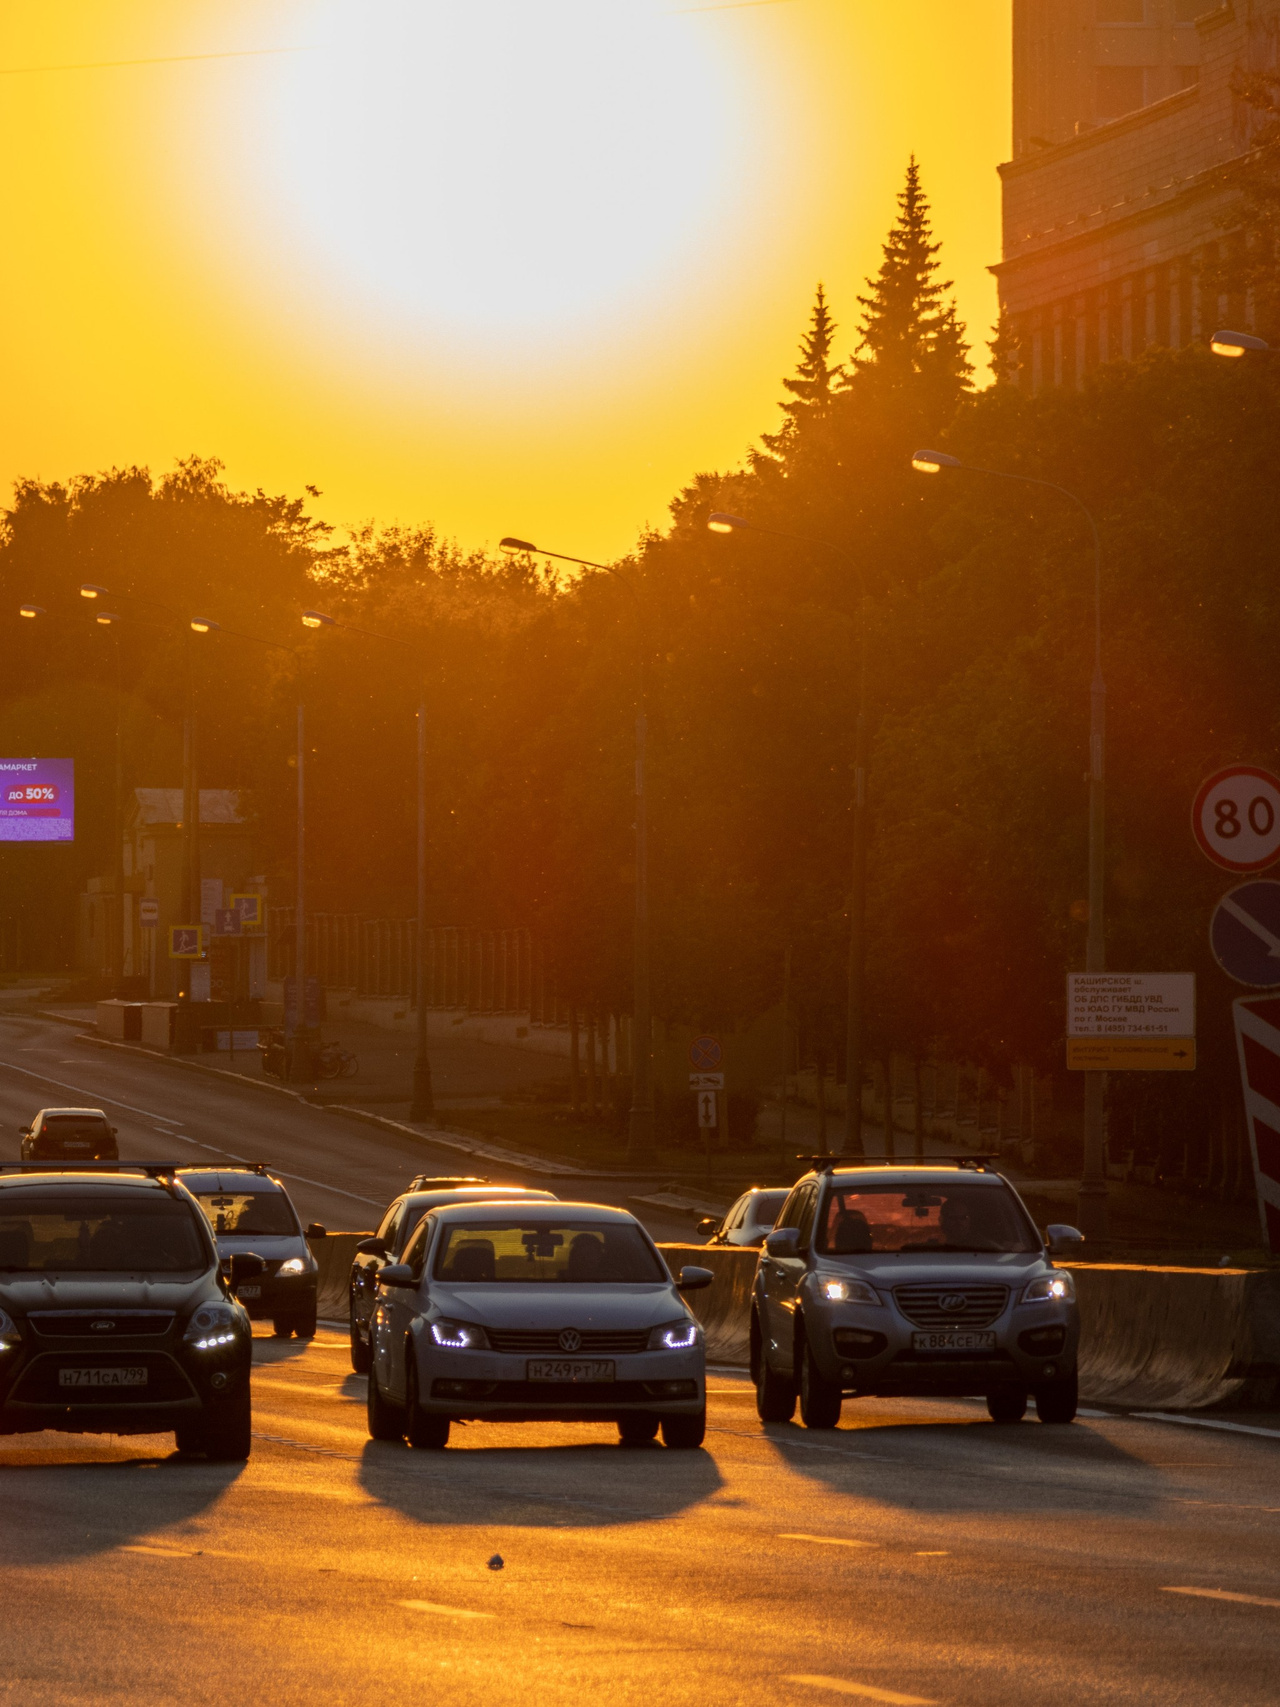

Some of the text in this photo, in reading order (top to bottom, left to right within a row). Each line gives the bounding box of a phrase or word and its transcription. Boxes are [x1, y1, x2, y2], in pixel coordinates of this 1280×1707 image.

[25, 787, 55, 800] 50%
[1214, 795, 1275, 839] 80
[1074, 977, 1132, 985] КАШИРСКОЕ
[1074, 985, 1132, 994] обслуживает
[1074, 995, 1163, 1004] ОБ ДПС ГИБДД УВД
[1087, 1005, 1109, 1013] ЮАО
[1111, 1005, 1123, 1013] ГУ
[1125, 1005, 1145, 1013] МВД
[1147, 1005, 1180, 1013] России
[1095, 1014, 1128, 1022] Москве
[1096, 1024, 1102, 1032] 8
[1104, 1024, 1125, 1033] (495)
[1127, 1024, 1168, 1032] 734-61-51
